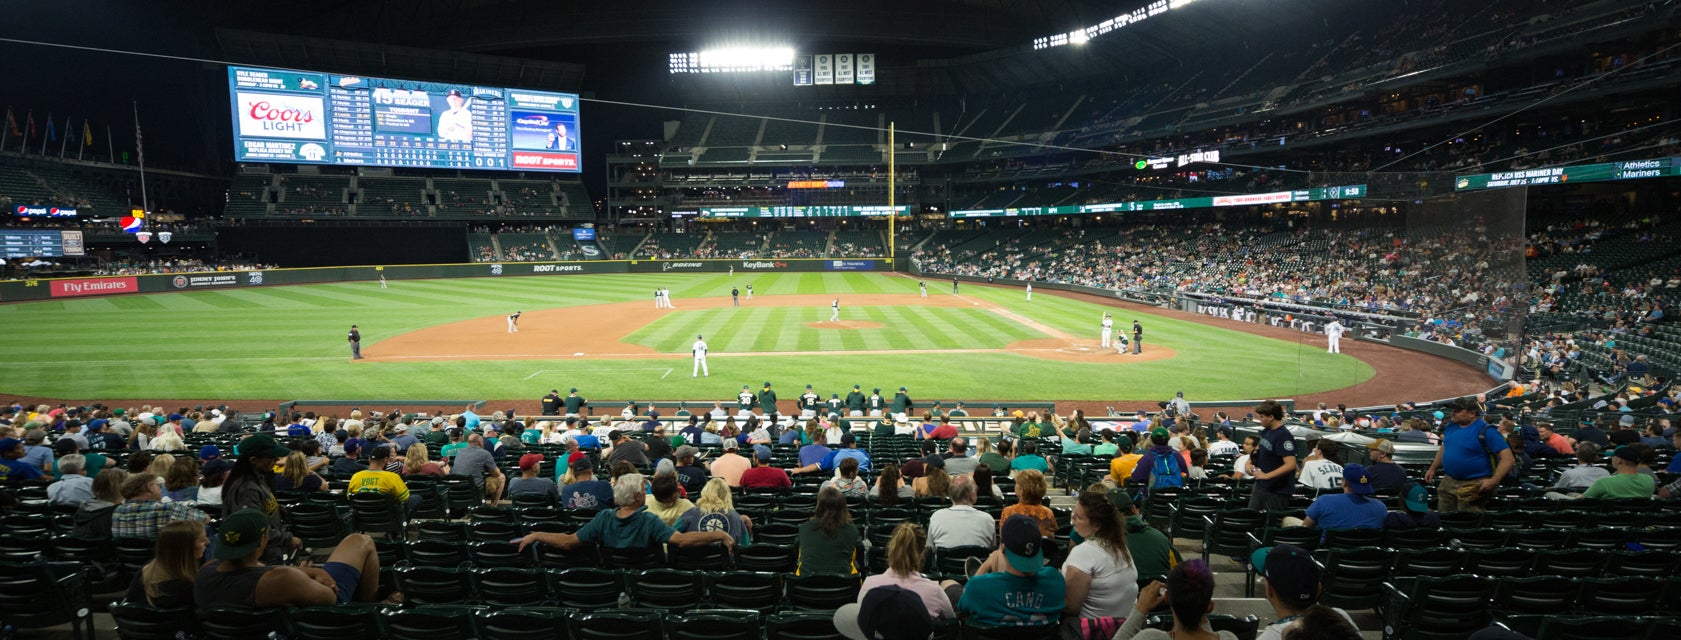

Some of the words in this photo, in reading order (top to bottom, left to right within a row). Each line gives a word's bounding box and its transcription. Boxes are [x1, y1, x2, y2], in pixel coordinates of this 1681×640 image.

[372, 90, 393, 104] 15
[394, 98, 430, 106] SEAGER
[249, 101, 314, 122] Coors
[263, 122, 302, 132] LIGHT
[515, 155, 542, 165] ROOT
[1204, 150, 1220, 163] CLUB
[476, 158, 482, 167] 0
[487, 158, 494, 167] 0
[499, 159, 504, 167] 1
[1624, 160, 1660, 169] Athletics
[1526, 169, 1551, 177] MARINER
[1623, 170, 1660, 178] Mariners
[64, 283, 81, 292] Fly
[84, 280, 126, 290] Emirates
[1317, 465, 1344, 475] SEAGE
[1025, 543, 1033, 555] S
[1005, 592, 1044, 609] CANO
